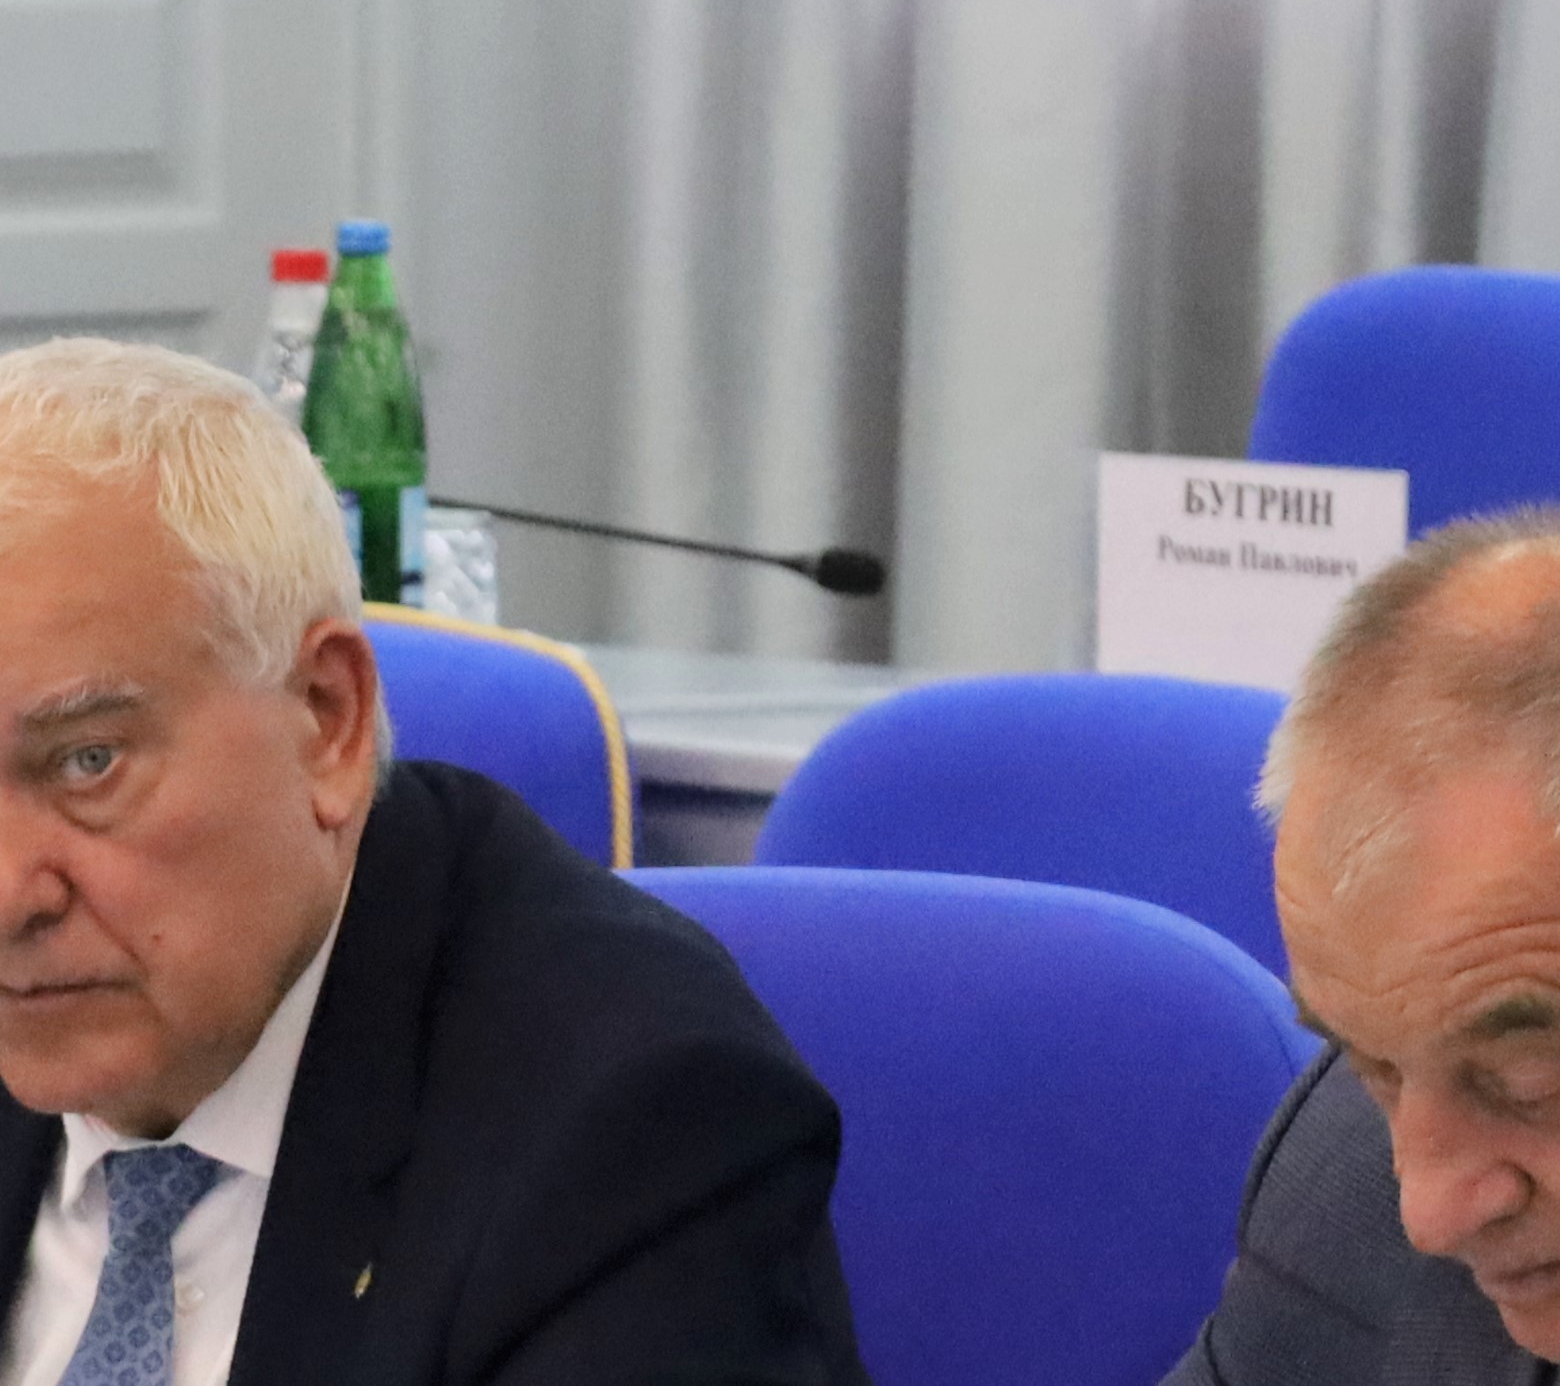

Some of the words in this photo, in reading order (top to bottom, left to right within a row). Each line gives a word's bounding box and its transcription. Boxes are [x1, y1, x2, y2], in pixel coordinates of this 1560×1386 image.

[1183, 477, 1334, 527] БУГРИН
[1157, 535, 1231, 569] Роман
[1239, 542, 1358, 579] Павлович
